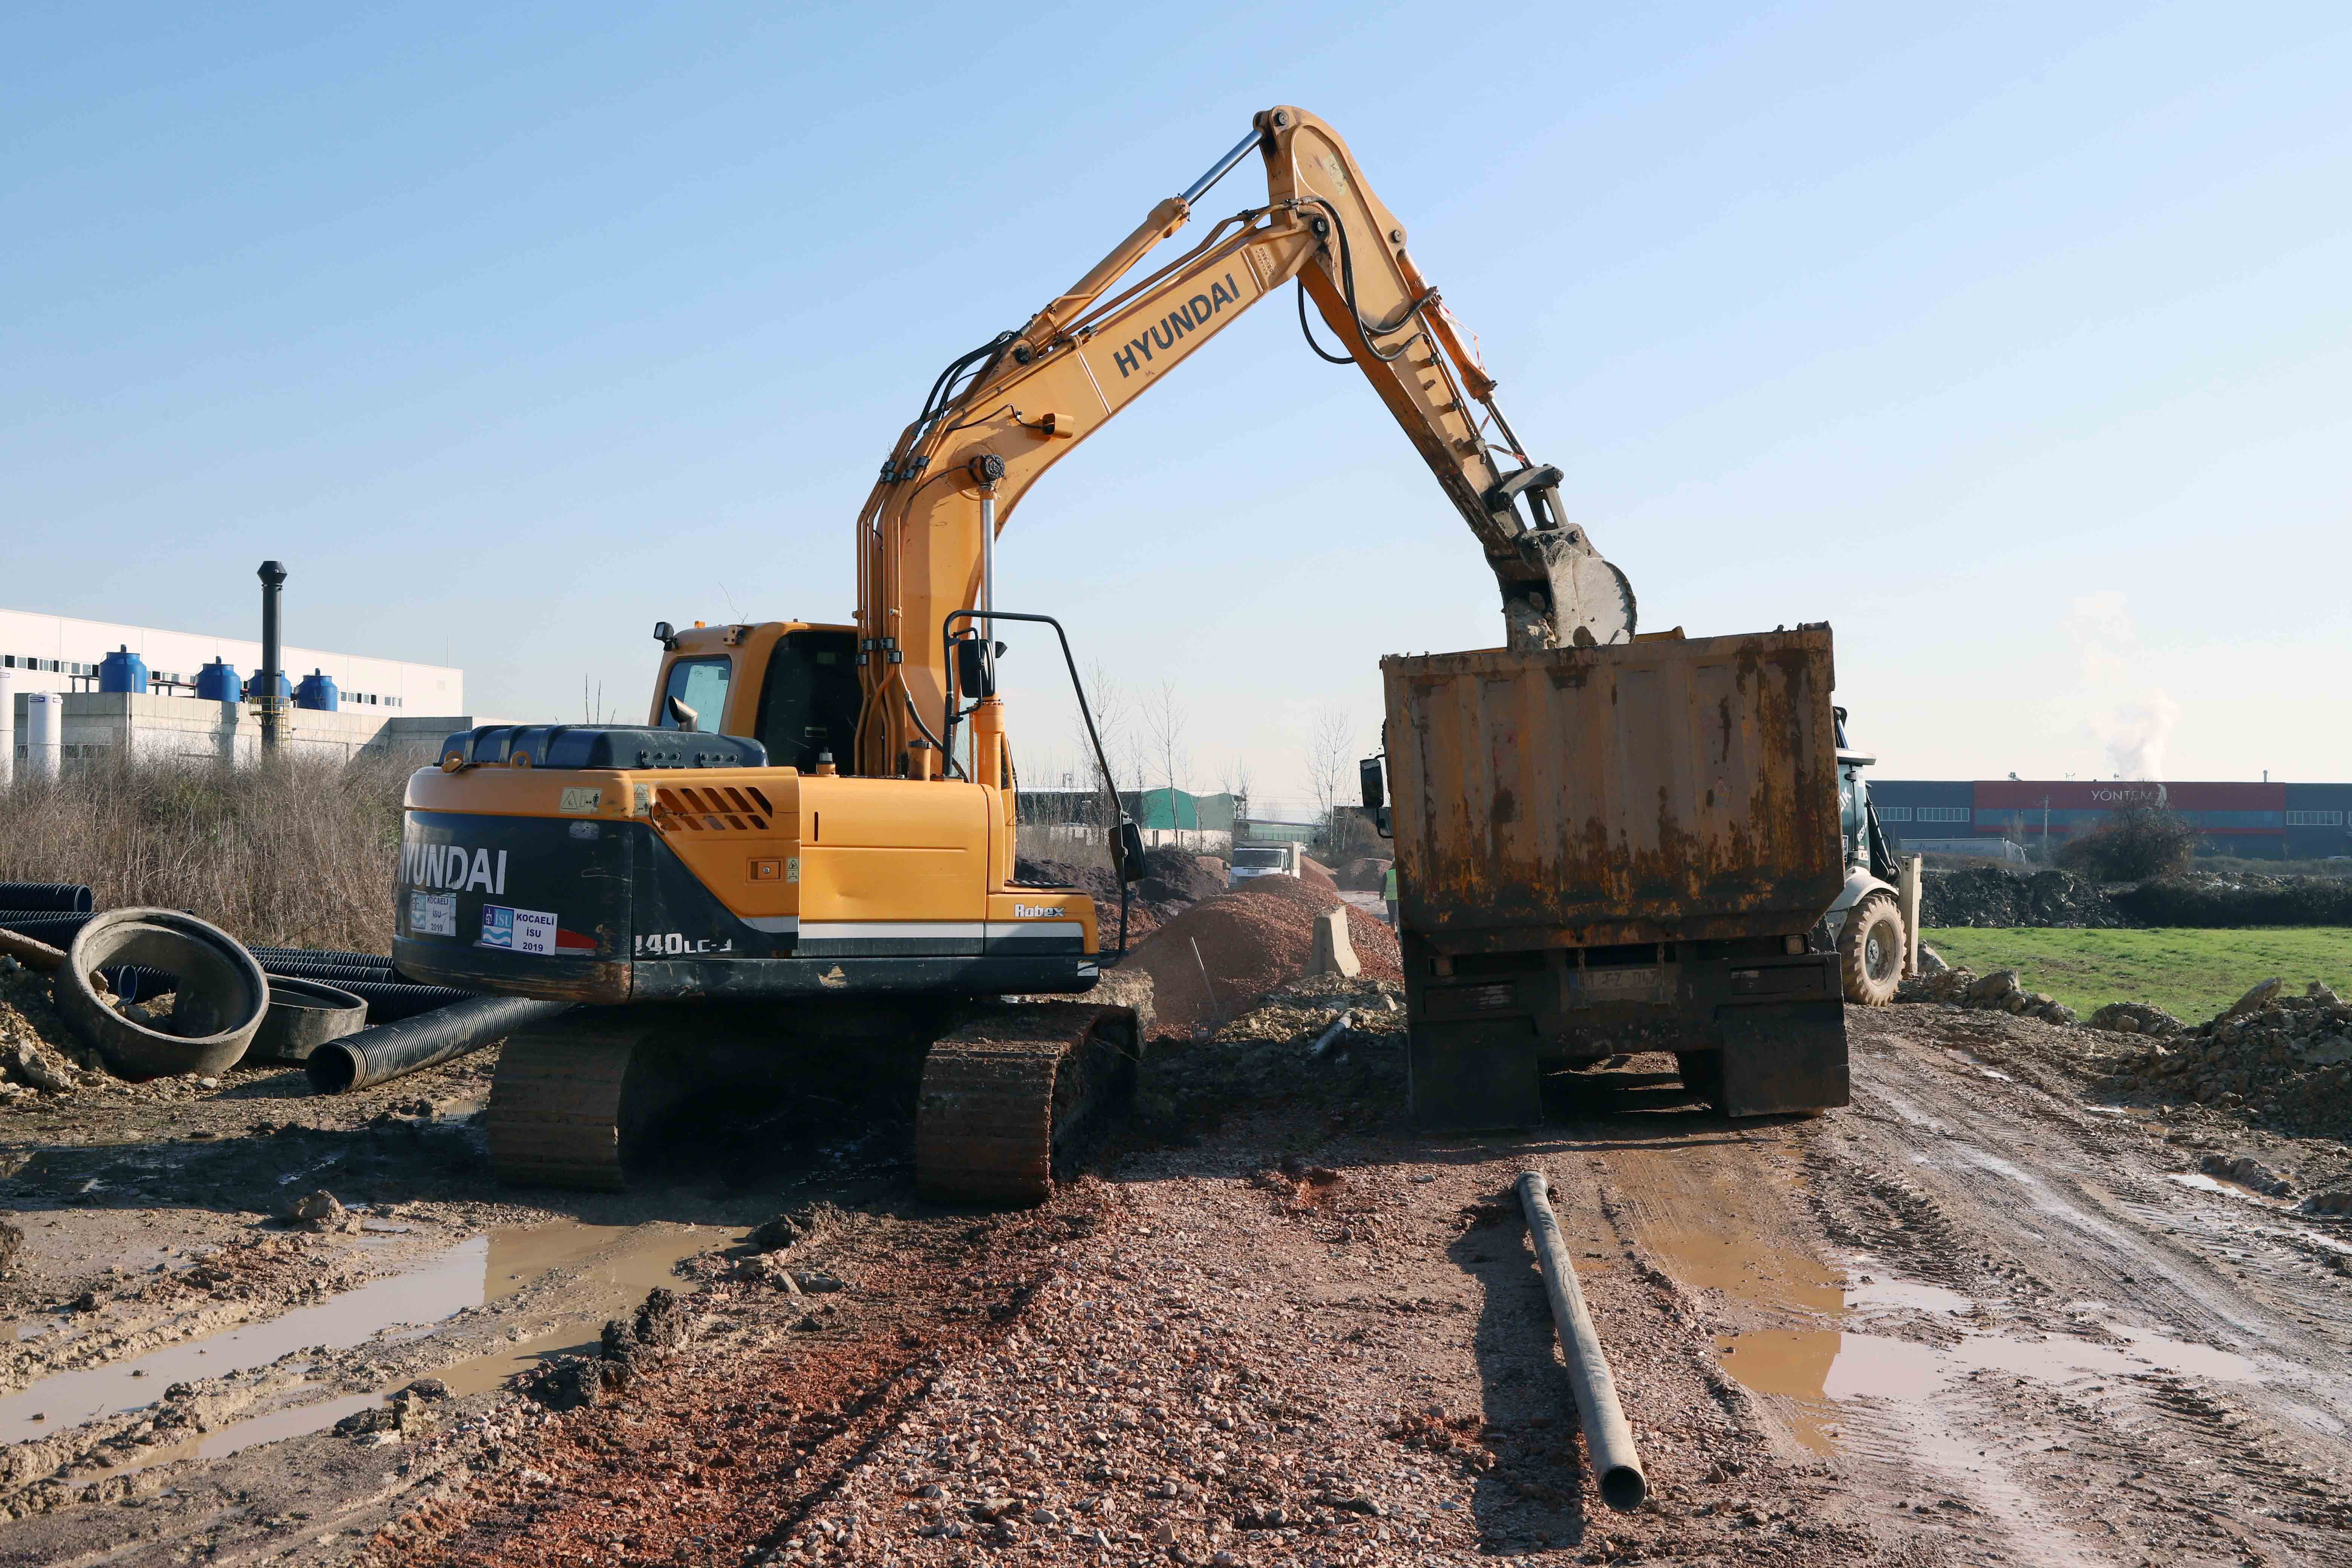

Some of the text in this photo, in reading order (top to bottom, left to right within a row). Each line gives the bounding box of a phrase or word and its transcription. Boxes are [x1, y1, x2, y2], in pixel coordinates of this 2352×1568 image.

[1113, 273, 1240, 378] HYUNDAI
[398, 841, 507, 894] HYUNDAI
[1015, 904, 1065, 917] Robex
[516, 913, 555, 925] KOCAELİ
[431, 923, 443, 932] 2019
[526, 927, 541, 937] İSU
[523, 942, 543, 952] 2019
